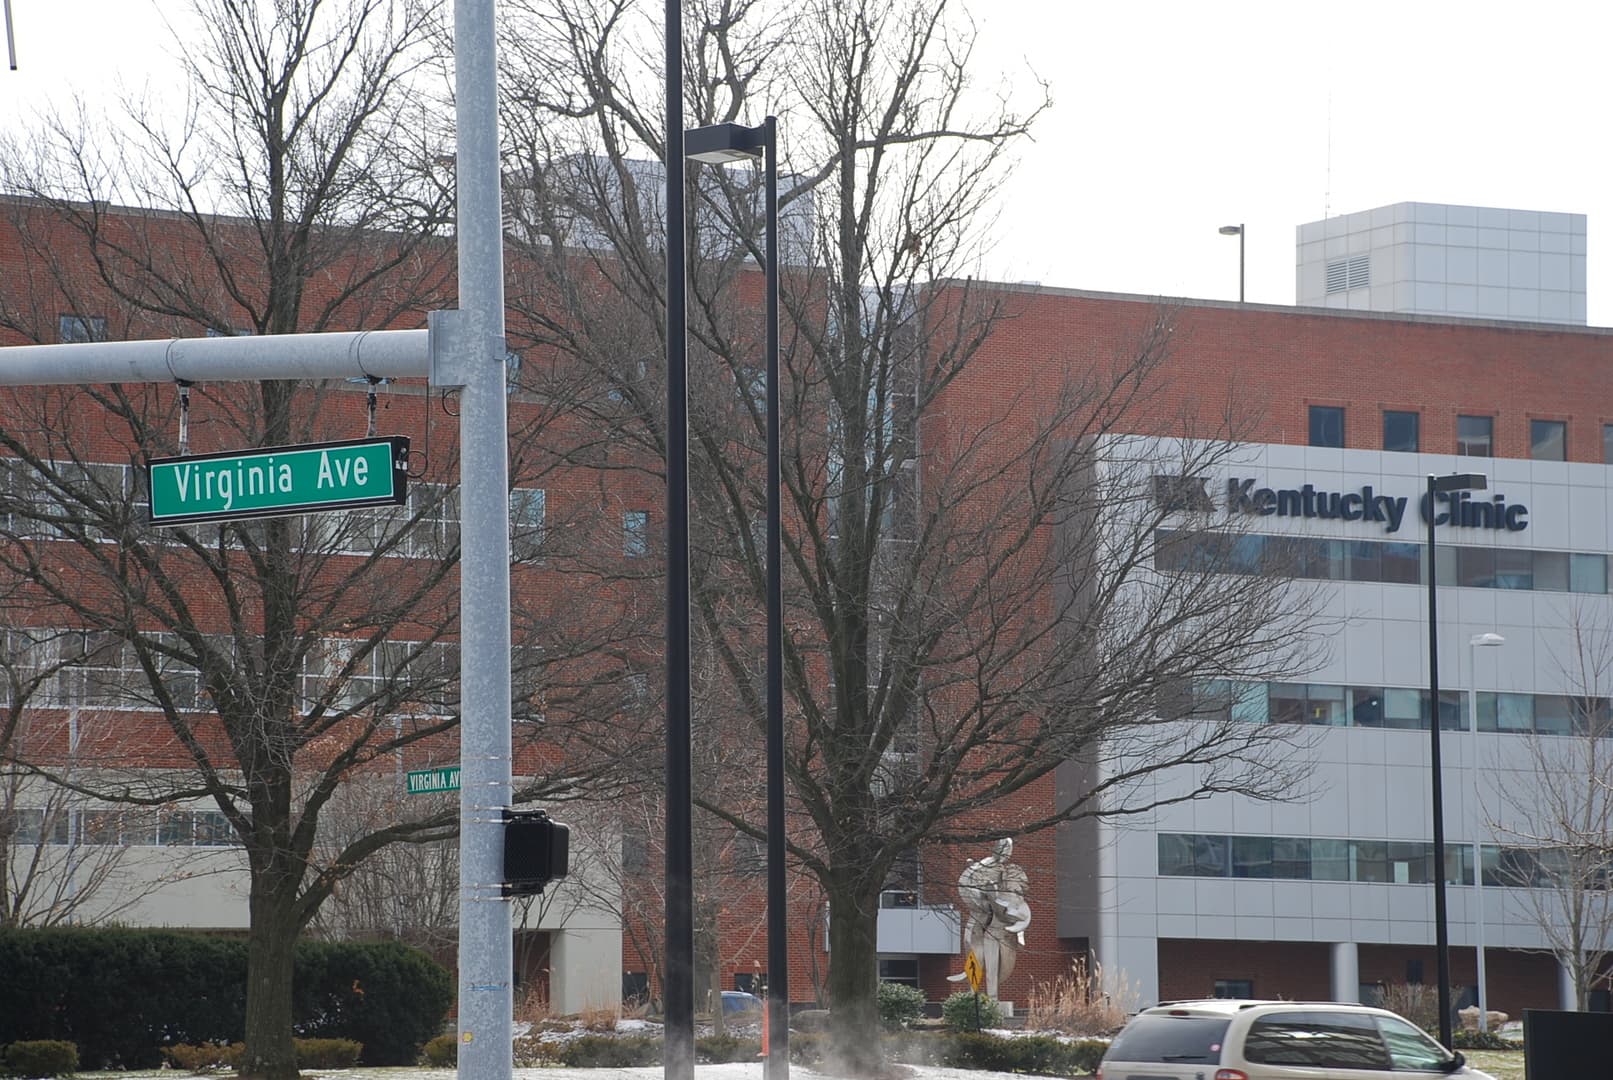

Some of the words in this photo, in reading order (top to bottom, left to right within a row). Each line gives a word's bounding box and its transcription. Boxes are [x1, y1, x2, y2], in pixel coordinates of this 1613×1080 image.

[174, 458, 293, 510] Virginia
[316, 450, 369, 489] Ave
[1228, 477, 1408, 533] Kentucky
[1420, 491, 1528, 532] Clinic
[410, 772, 447, 791] VIRGINIA
